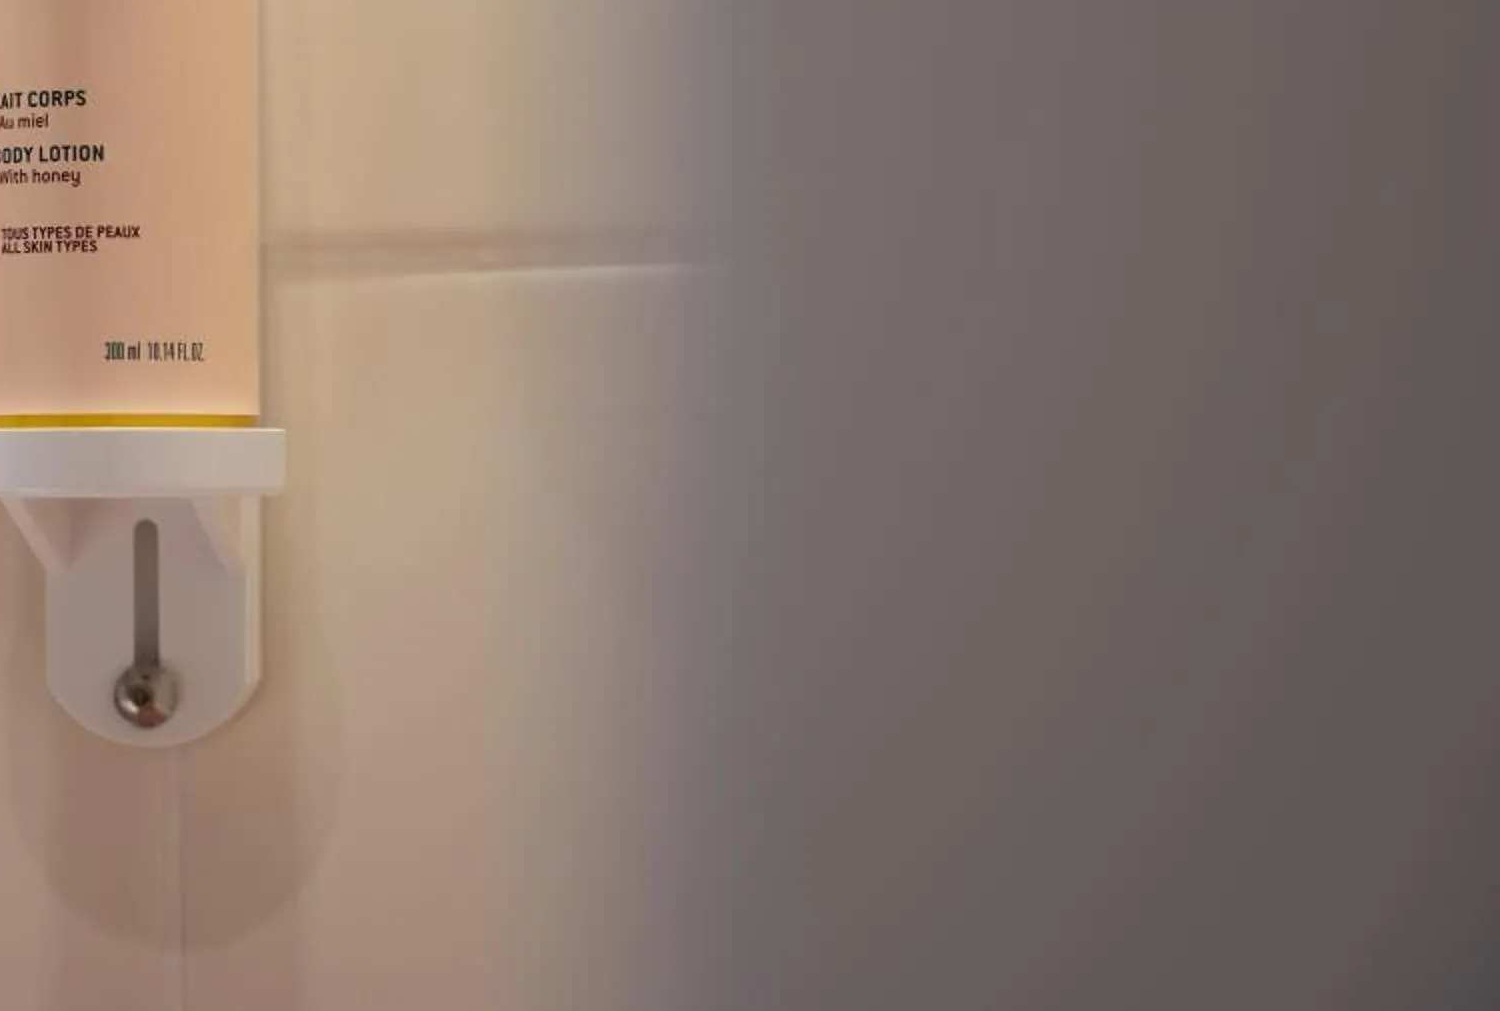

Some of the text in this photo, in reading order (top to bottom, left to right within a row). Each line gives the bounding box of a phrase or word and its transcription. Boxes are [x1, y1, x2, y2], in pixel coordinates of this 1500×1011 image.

[28, 90, 87, 107] CORPS
[18, 113, 49, 128] miel
[39, 145, 104, 162] LOTION
[0, 168, 81, 187] With honey
[1, 226, 140, 240] TOUS TYPES DE PEAUX
[1, 240, 97, 254] ALL SKIN TYPES
[128, 341, 140, 359] ml
